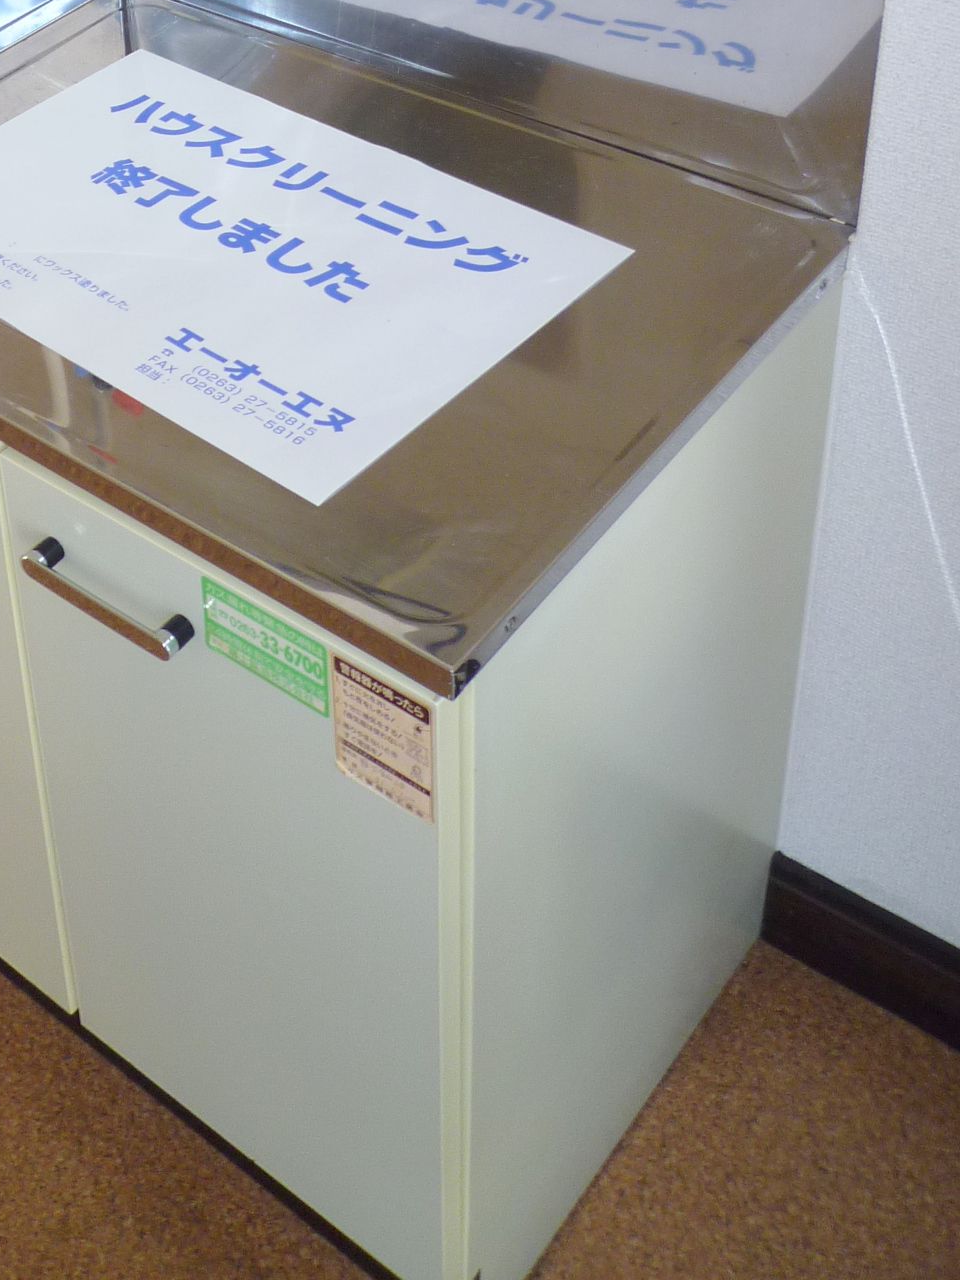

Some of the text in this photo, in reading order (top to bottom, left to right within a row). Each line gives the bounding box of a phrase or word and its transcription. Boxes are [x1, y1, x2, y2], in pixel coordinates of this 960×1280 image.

[91, 159, 371, 304] 終了しました
[110, 94, 530, 273] ハウスクリーニング
[148, 354, 179, 375] FAX
[165, 327, 356, 432] エーオーエヌ
